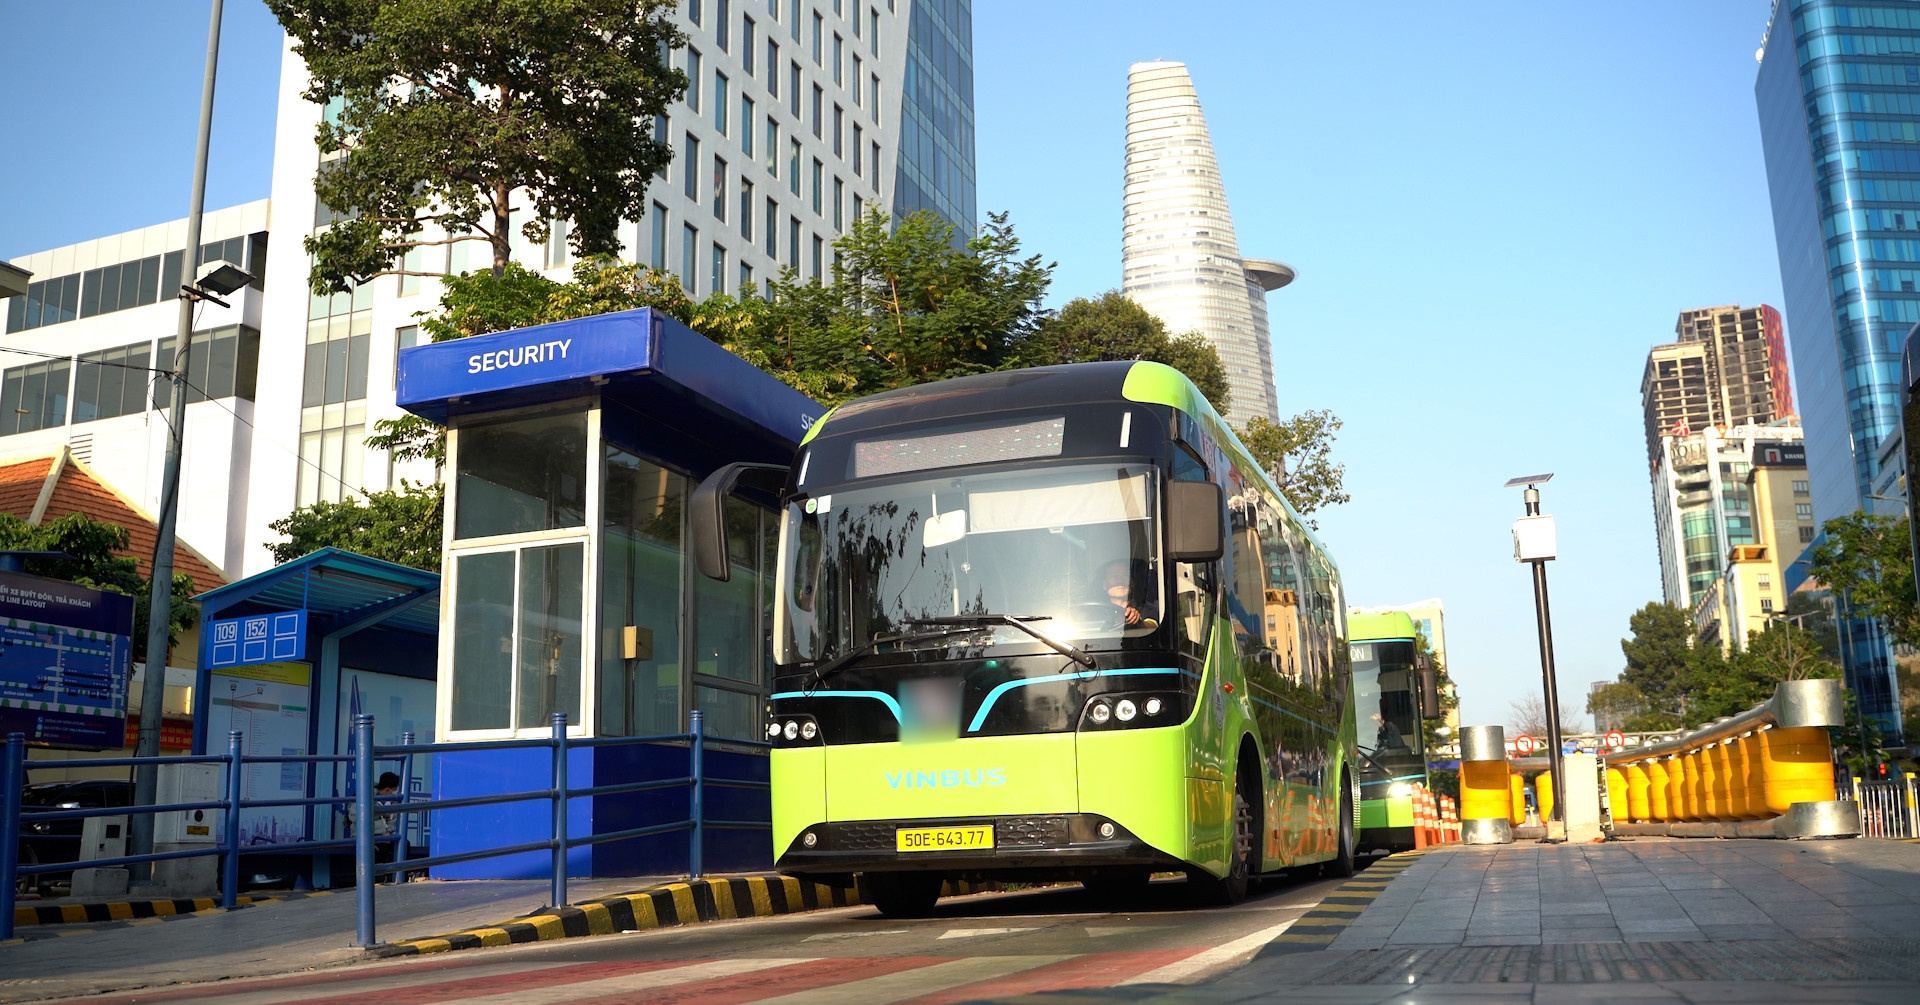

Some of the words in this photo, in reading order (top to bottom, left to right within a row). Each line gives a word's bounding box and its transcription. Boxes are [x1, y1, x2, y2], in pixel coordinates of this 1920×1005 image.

[467, 338, 572, 374] SECURITY
[6, 596, 20, 605] LINE
[21, 598, 46, 609] LAYOUT
[10, 588, 19, 596] XE
[20, 589, 37, 599] BUÝT
[69, 598, 91, 608] KHÁCH
[217, 624, 236, 640] 109
[247, 621, 266, 637] 152
[885, 768, 1007, 790] VINBUS
